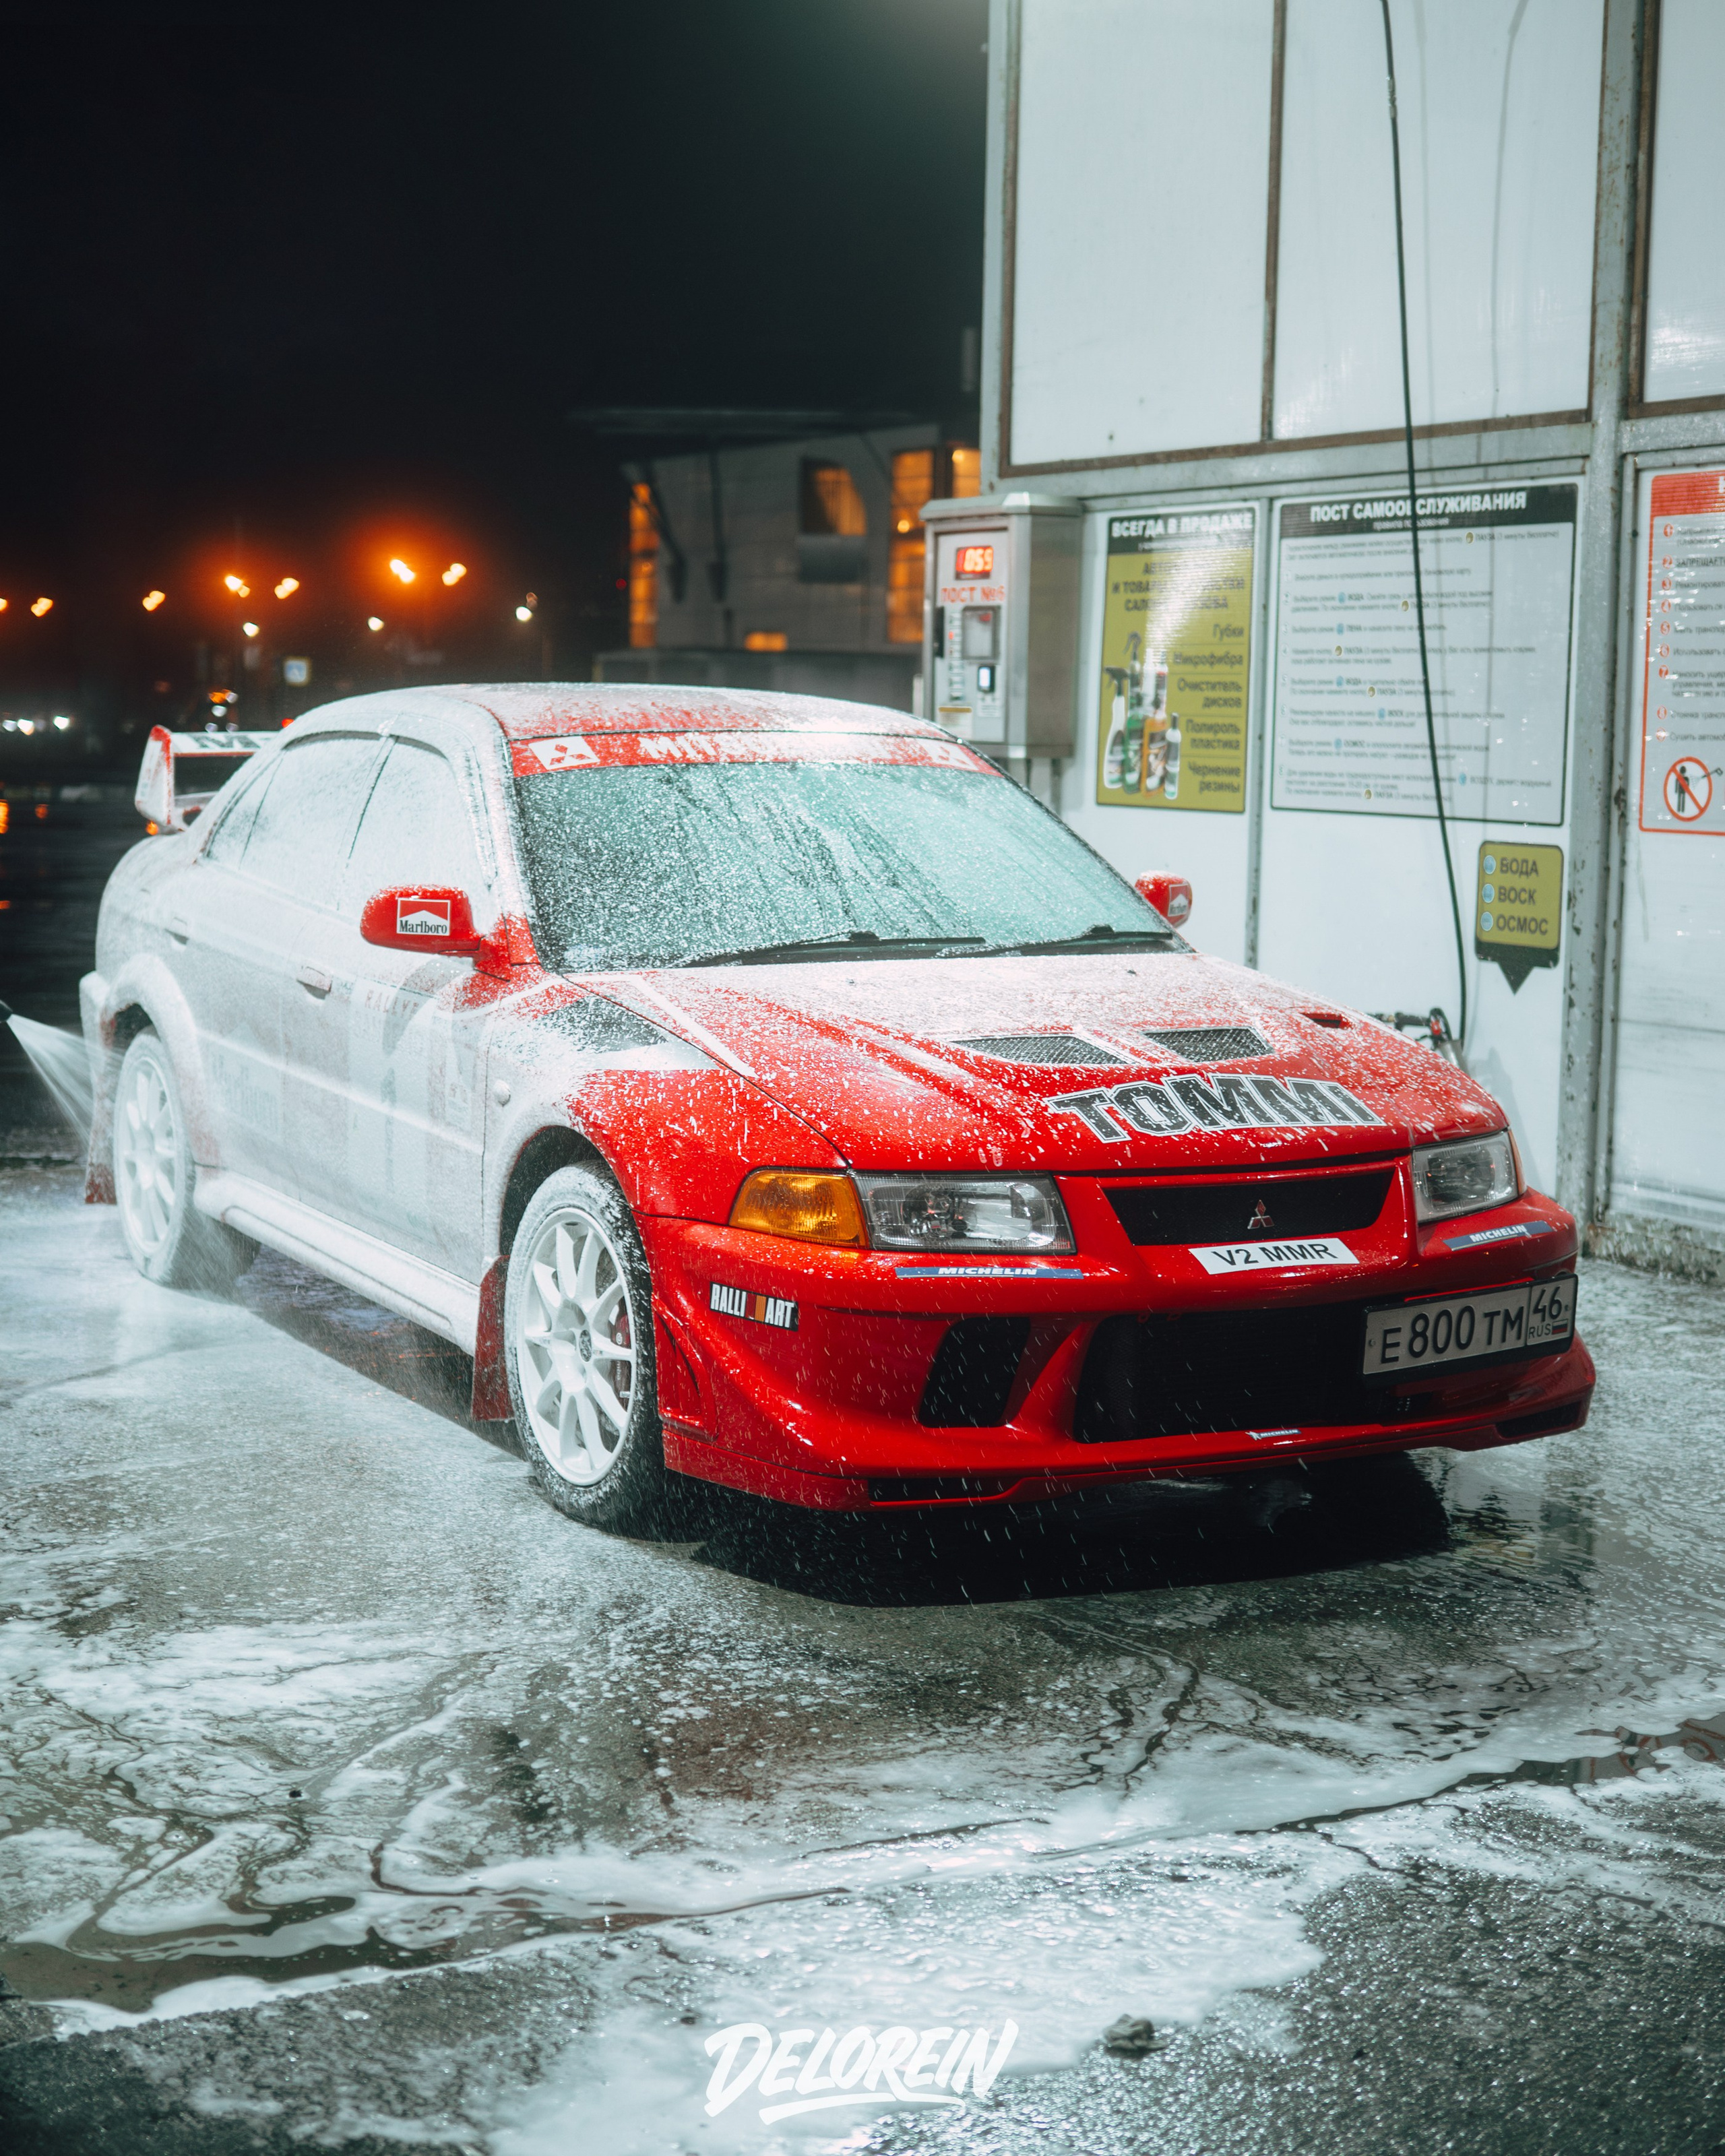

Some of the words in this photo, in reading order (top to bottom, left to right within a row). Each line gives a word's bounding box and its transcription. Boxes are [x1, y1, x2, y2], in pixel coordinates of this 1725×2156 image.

[1309, 504, 1350, 522] ПОСТ
[1112, 517, 1165, 538] ВСЕГДА
[1167, 517, 1177, 534] В
[1181, 512, 1253, 533] ПРОДАЖЕ
[941, 586, 976, 603] ПОСТ
[1213, 624, 1244, 641] Губки
[1174, 651, 1243, 668] Микрофибра
[1177, 677, 1243, 692] Очиститель
[1500, 857, 1539, 878] ВОДА
[1498, 886, 1536, 906] ВОСК
[399, 920, 448, 934] Marlboro
[1496, 914, 1548, 935] ОСМОС
[1044, 1074, 1387, 1143] TOMMI
[1469, 1225, 1528, 1242] MICHELIN
[1211, 1248, 1259, 1266] V2
[1259, 1243, 1339, 1262] MMR
[938, 1267, 1038, 1275] MICHELIN
[710, 1283, 747, 1317] RALLI
[765, 1297, 794, 1328] ART
[1533, 1286, 1563, 1323] 46
[1528, 1323, 1551, 1339] RUS
[1259, 1429, 1298, 1438] MICHELIN
